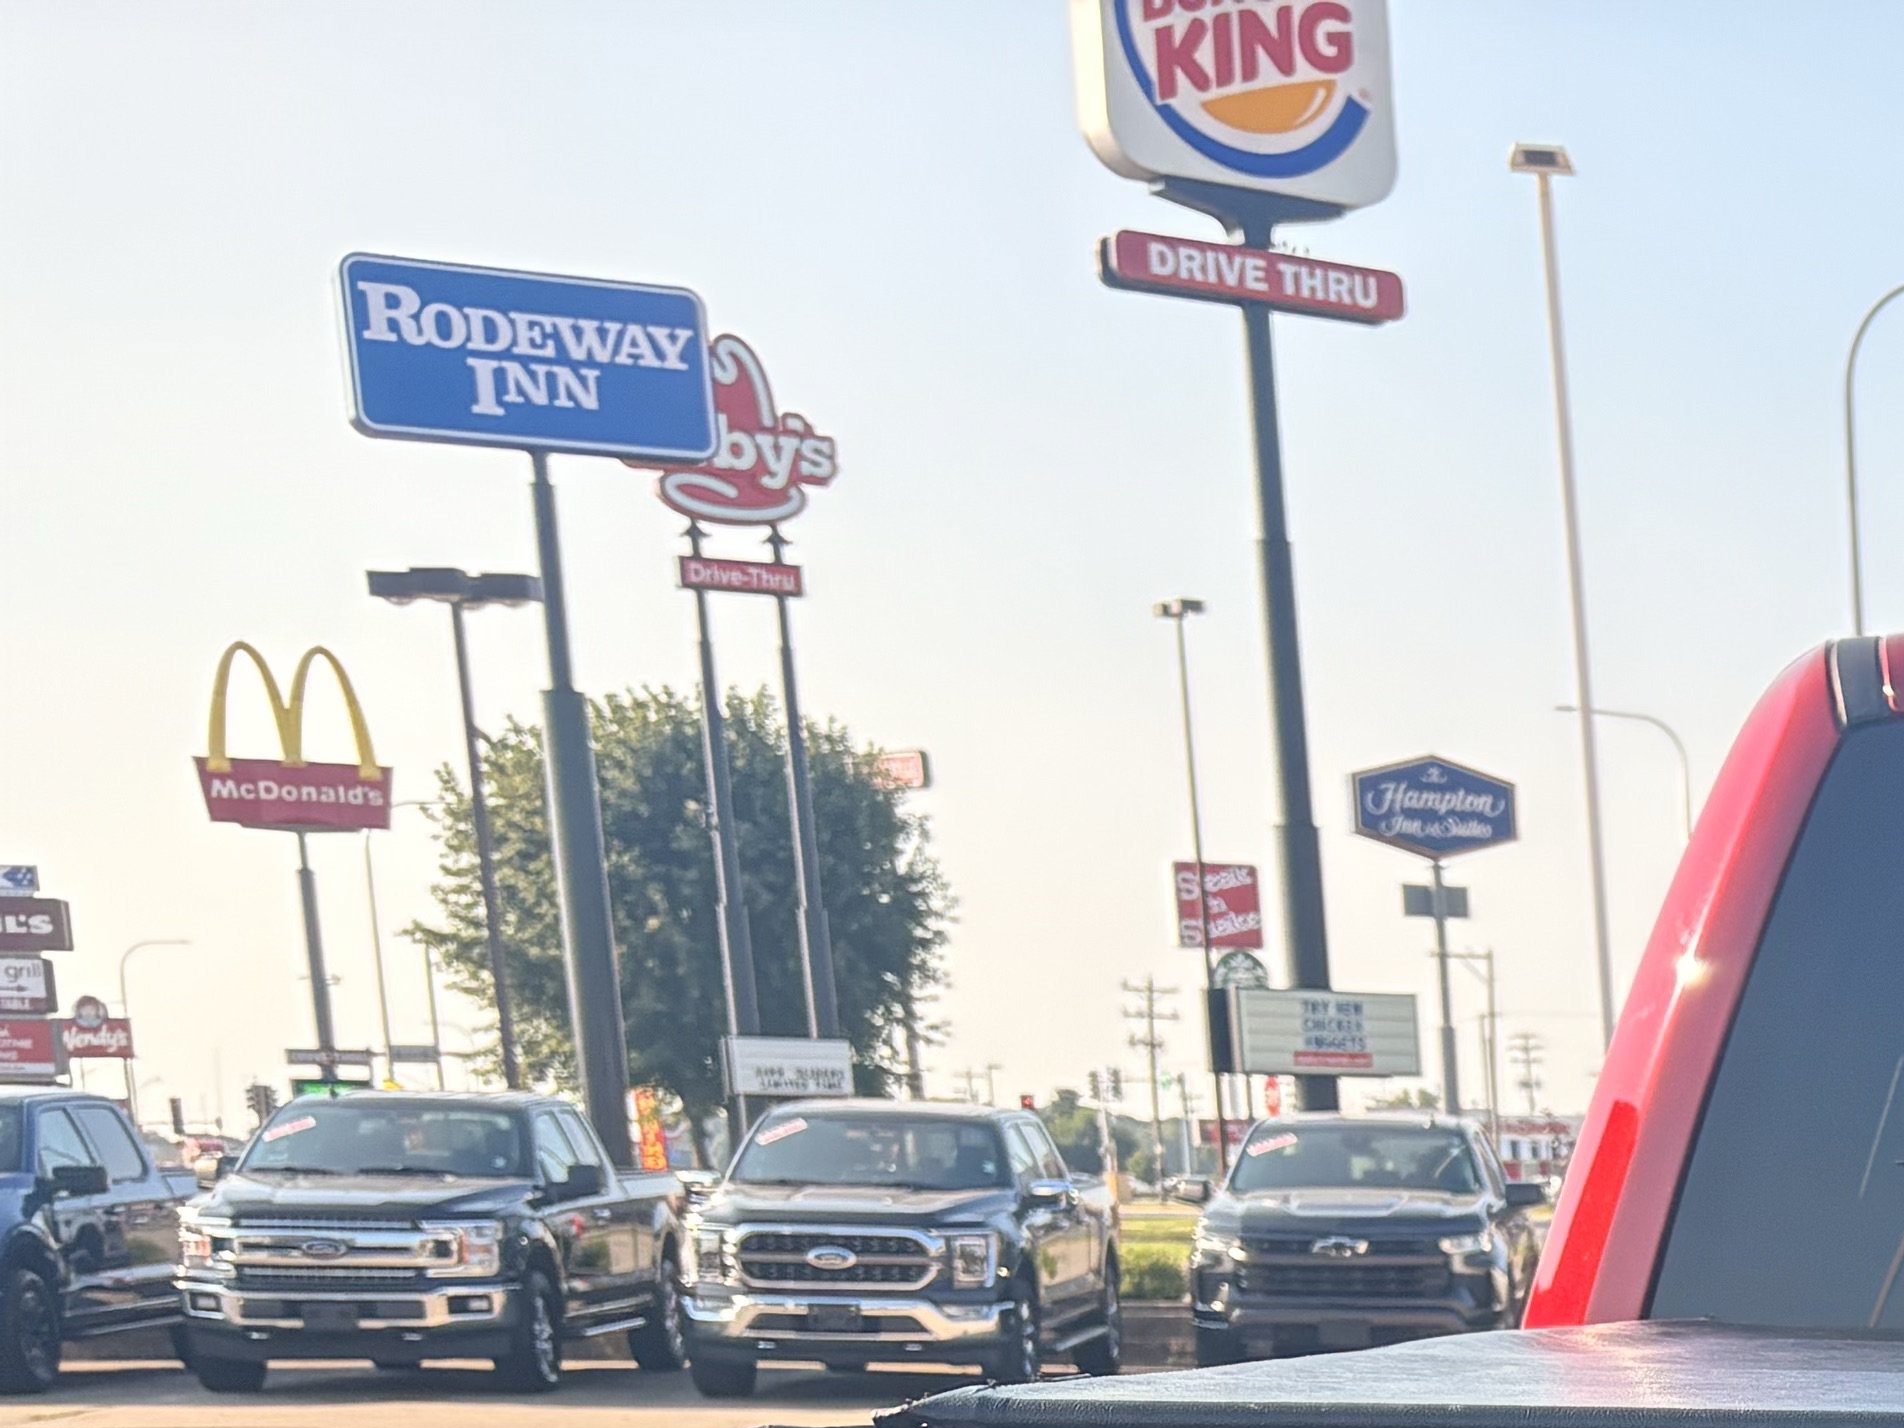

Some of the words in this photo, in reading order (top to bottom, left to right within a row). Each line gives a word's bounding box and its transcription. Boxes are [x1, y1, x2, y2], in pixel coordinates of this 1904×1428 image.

[1155, 2, 1353, 100] KING
[1147, 242, 1269, 291] DRIVE
[1275, 261, 1378, 308] THRU
[357, 281, 693, 370] RODEWAY
[466, 357, 600, 416] INN
[713, 413, 834, 489] by's
[690, 563, 795, 591] Drive-Thru
[210, 778, 384, 806] McDonald's
[1366, 780, 1505, 818] Hampton
[0, 914, 53, 934] L'S
[63, 1024, 128, 1053] Wendy's
